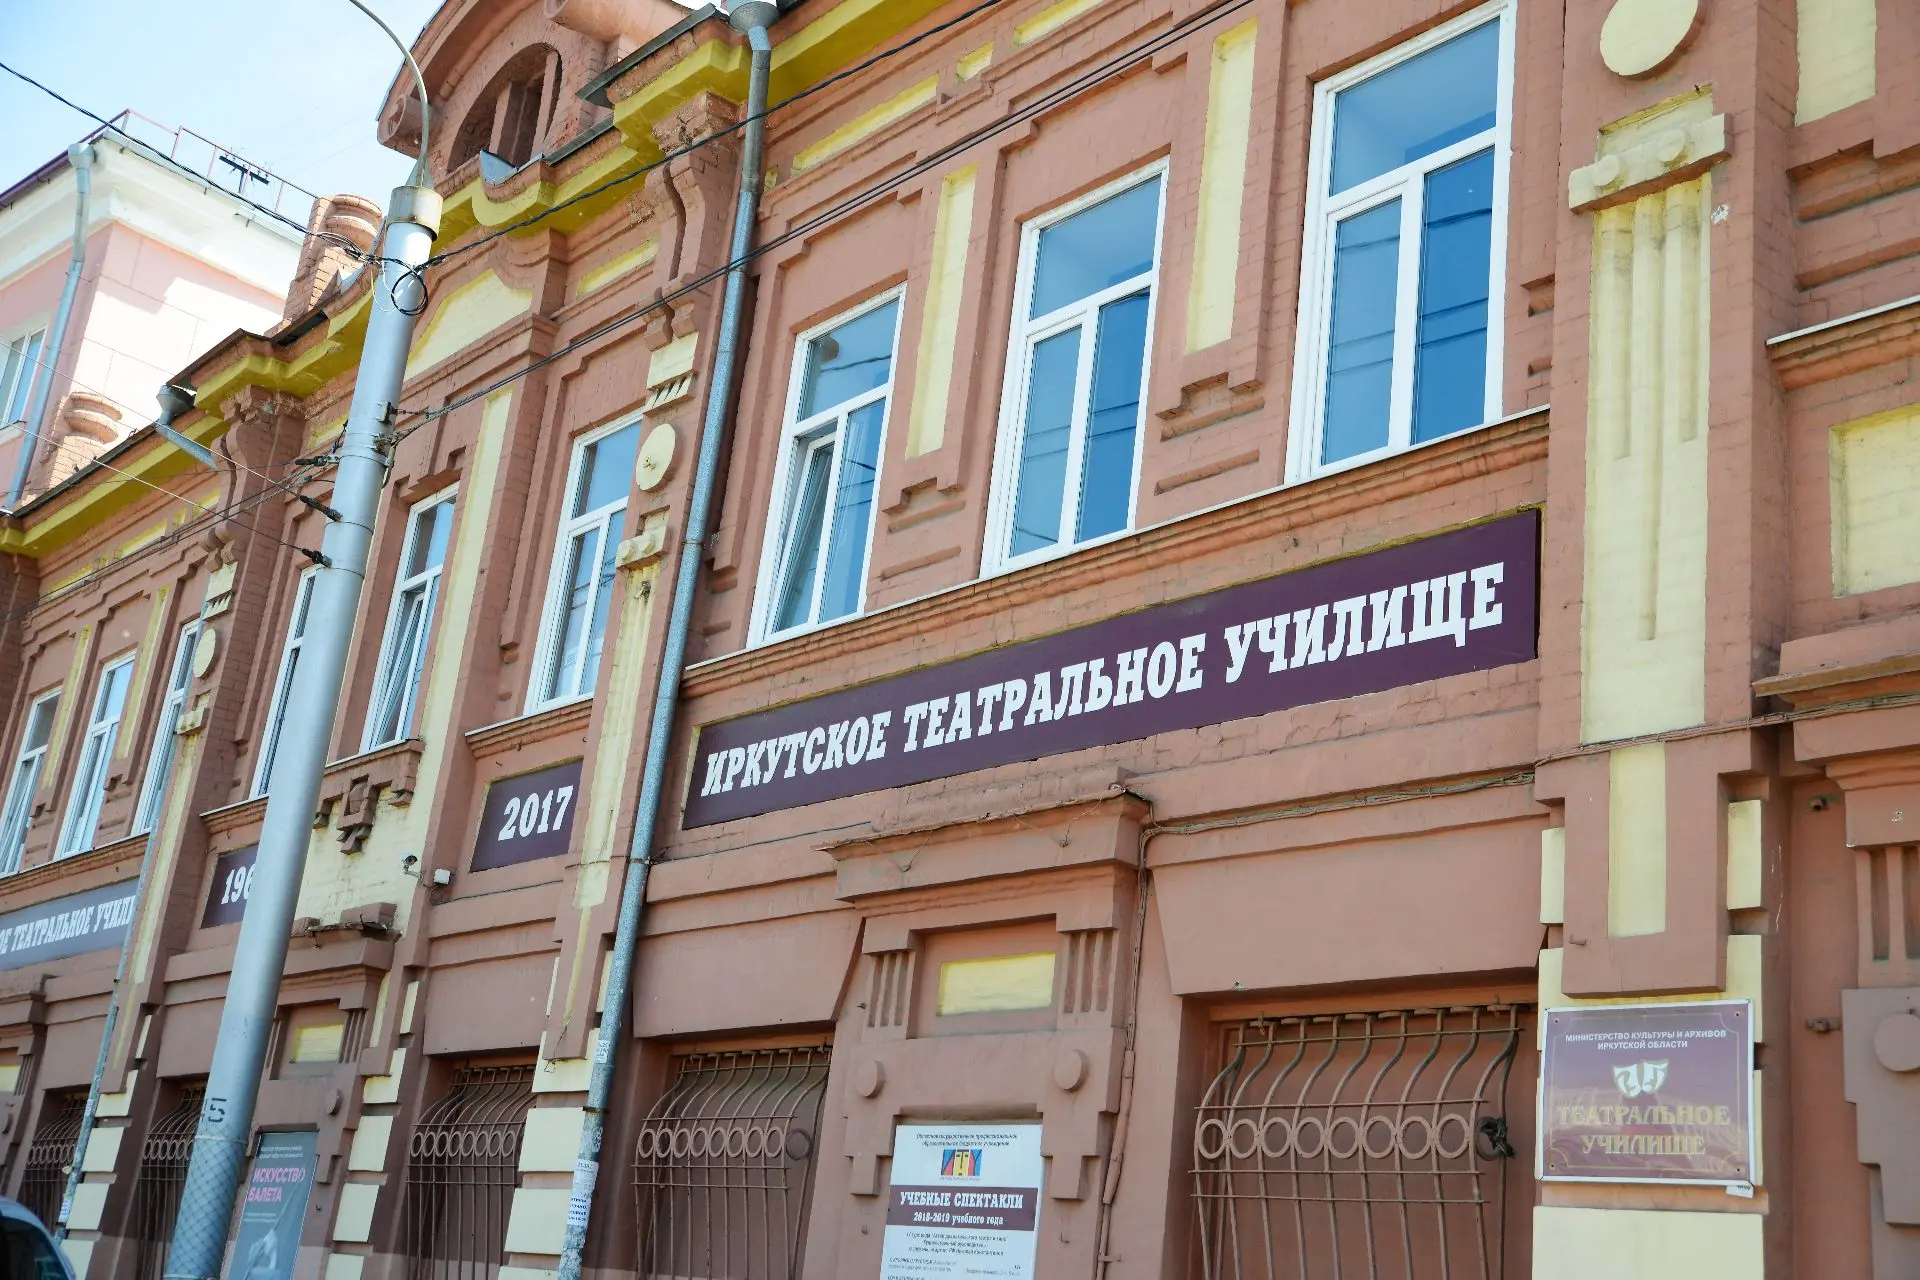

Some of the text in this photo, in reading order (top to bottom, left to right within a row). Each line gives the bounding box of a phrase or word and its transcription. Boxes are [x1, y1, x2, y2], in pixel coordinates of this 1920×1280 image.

[701, 562, 1504, 798] ИРКУТСКОЕ ТЕАТРАЛЬНОЕ УЧИЛИЩЕ
[498, 785, 573, 841] 2017
[11, 905, 94, 953] ТЕАТРАЛЬНОЕ
[1566, 1032, 1629, 1043] МИНИСТЕРСТВО
[1632, 1031, 1675, 1041] КУЛЬТУРЫ
[1685, 1030, 1727, 1039] АРХИВОВ
[1598, 1040, 1688, 1050] ИРКУТСКОЙ ОБЛАСТИ
[1557, 1105, 1731, 1125] ТЕАТРАЛЬНОЕ
[1582, 1134, 1705, 1160] УЧИЛИЩЕ
[253, 1168, 306, 1183] ИСКУССТВО
[248, 1187, 282, 1202] БАЛЕТА
[900, 1191, 1024, 1209] УЧЕБНЫЕ СПЕКТАКЛИ
[913, 1212, 1004, 1227] 2018-2019 учебного года
